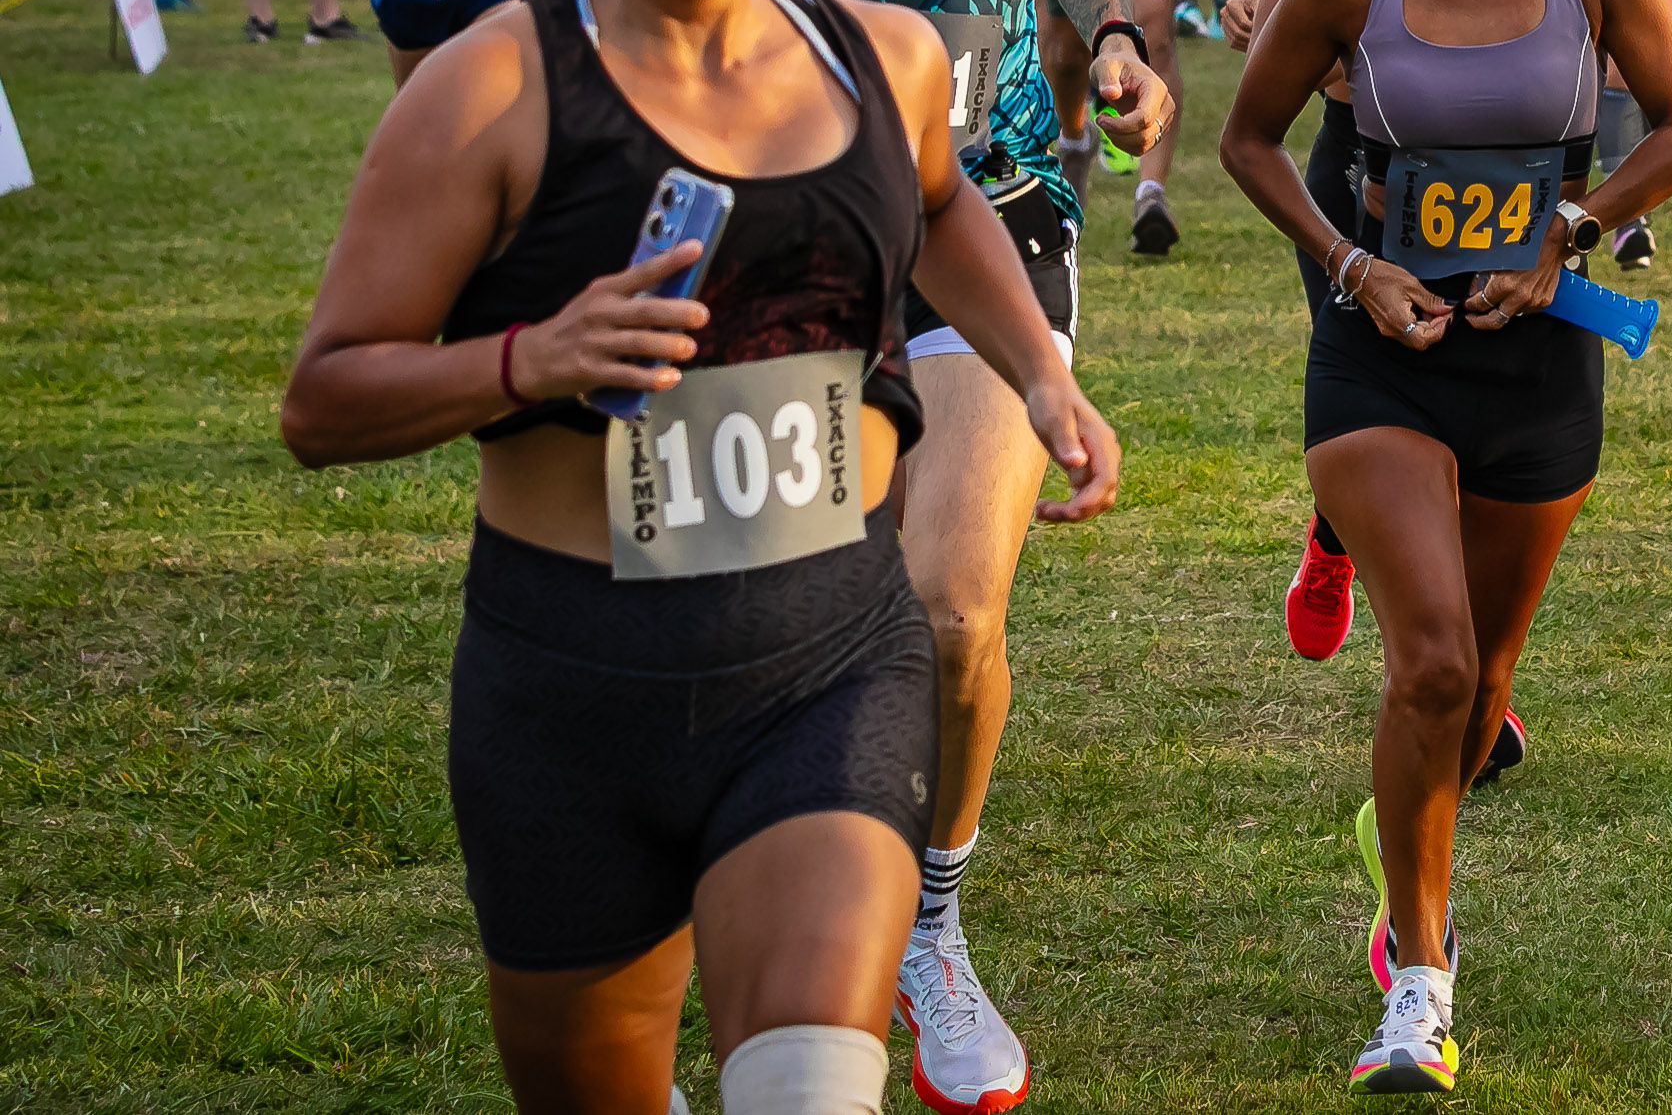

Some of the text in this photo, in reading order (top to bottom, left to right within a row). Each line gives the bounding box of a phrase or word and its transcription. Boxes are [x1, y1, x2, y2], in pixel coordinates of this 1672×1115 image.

[948, 51, 972, 127] 1
[968, 48, 991, 135] EXACTO
[1400, 171, 1419, 248] TIEMPO
[1421, 182, 1531, 249] 624
[656, 400, 822, 528] 103
[825, 382, 848, 506] EXACTO
[1395, 995, 1419, 1015] 824
